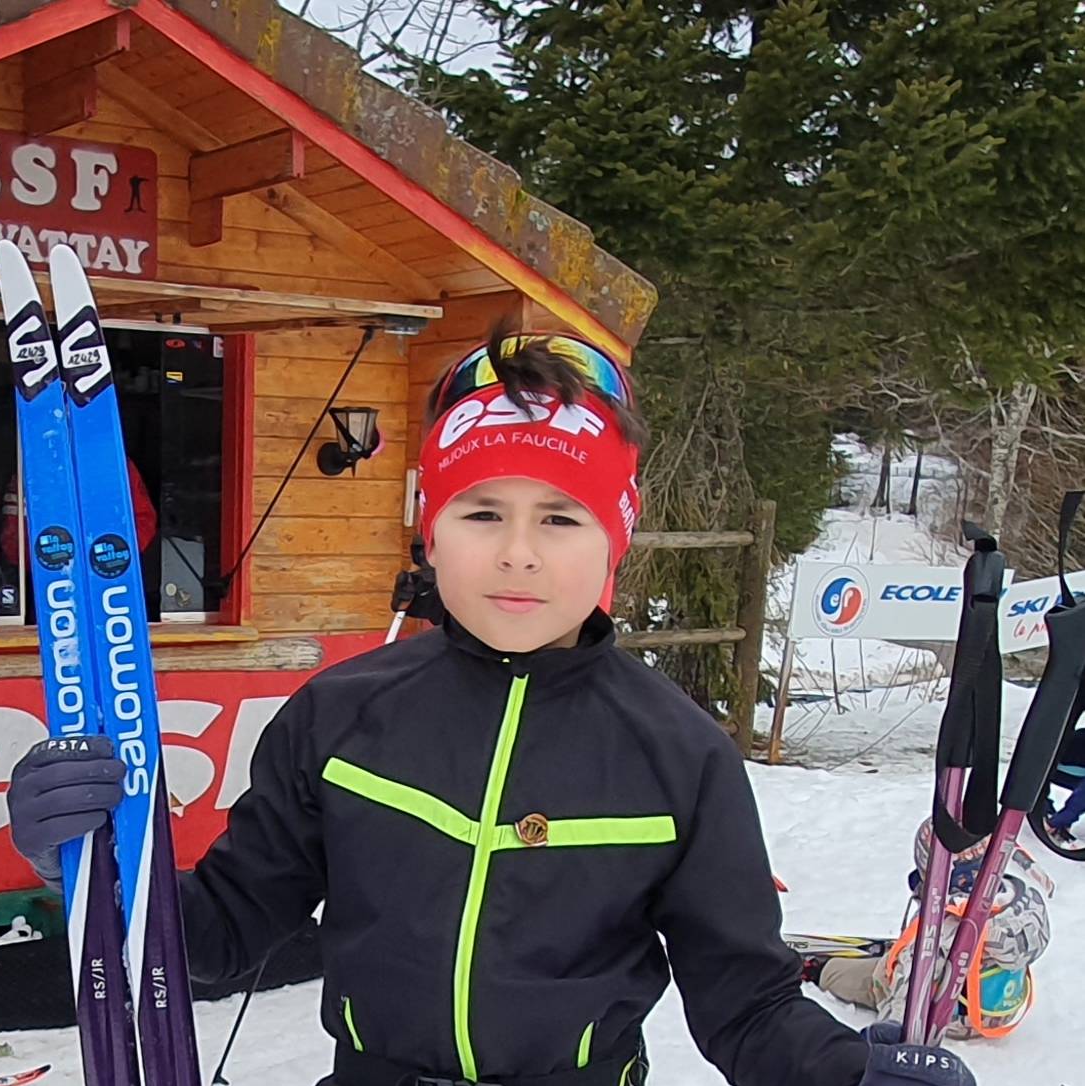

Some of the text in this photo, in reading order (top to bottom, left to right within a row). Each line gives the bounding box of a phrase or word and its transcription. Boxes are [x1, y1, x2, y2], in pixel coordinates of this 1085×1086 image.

[483, 433, 507, 448] LA
[511, 431, 590, 465] FAUCILLE
[880, 584, 962, 602] ECOLE
[1007, 595, 1050, 618] SKI
[102, 585, 149, 797] salomon
[91, 958, 106, 1000] RS/JR
[151, 966, 168, 1009] RS/JR
